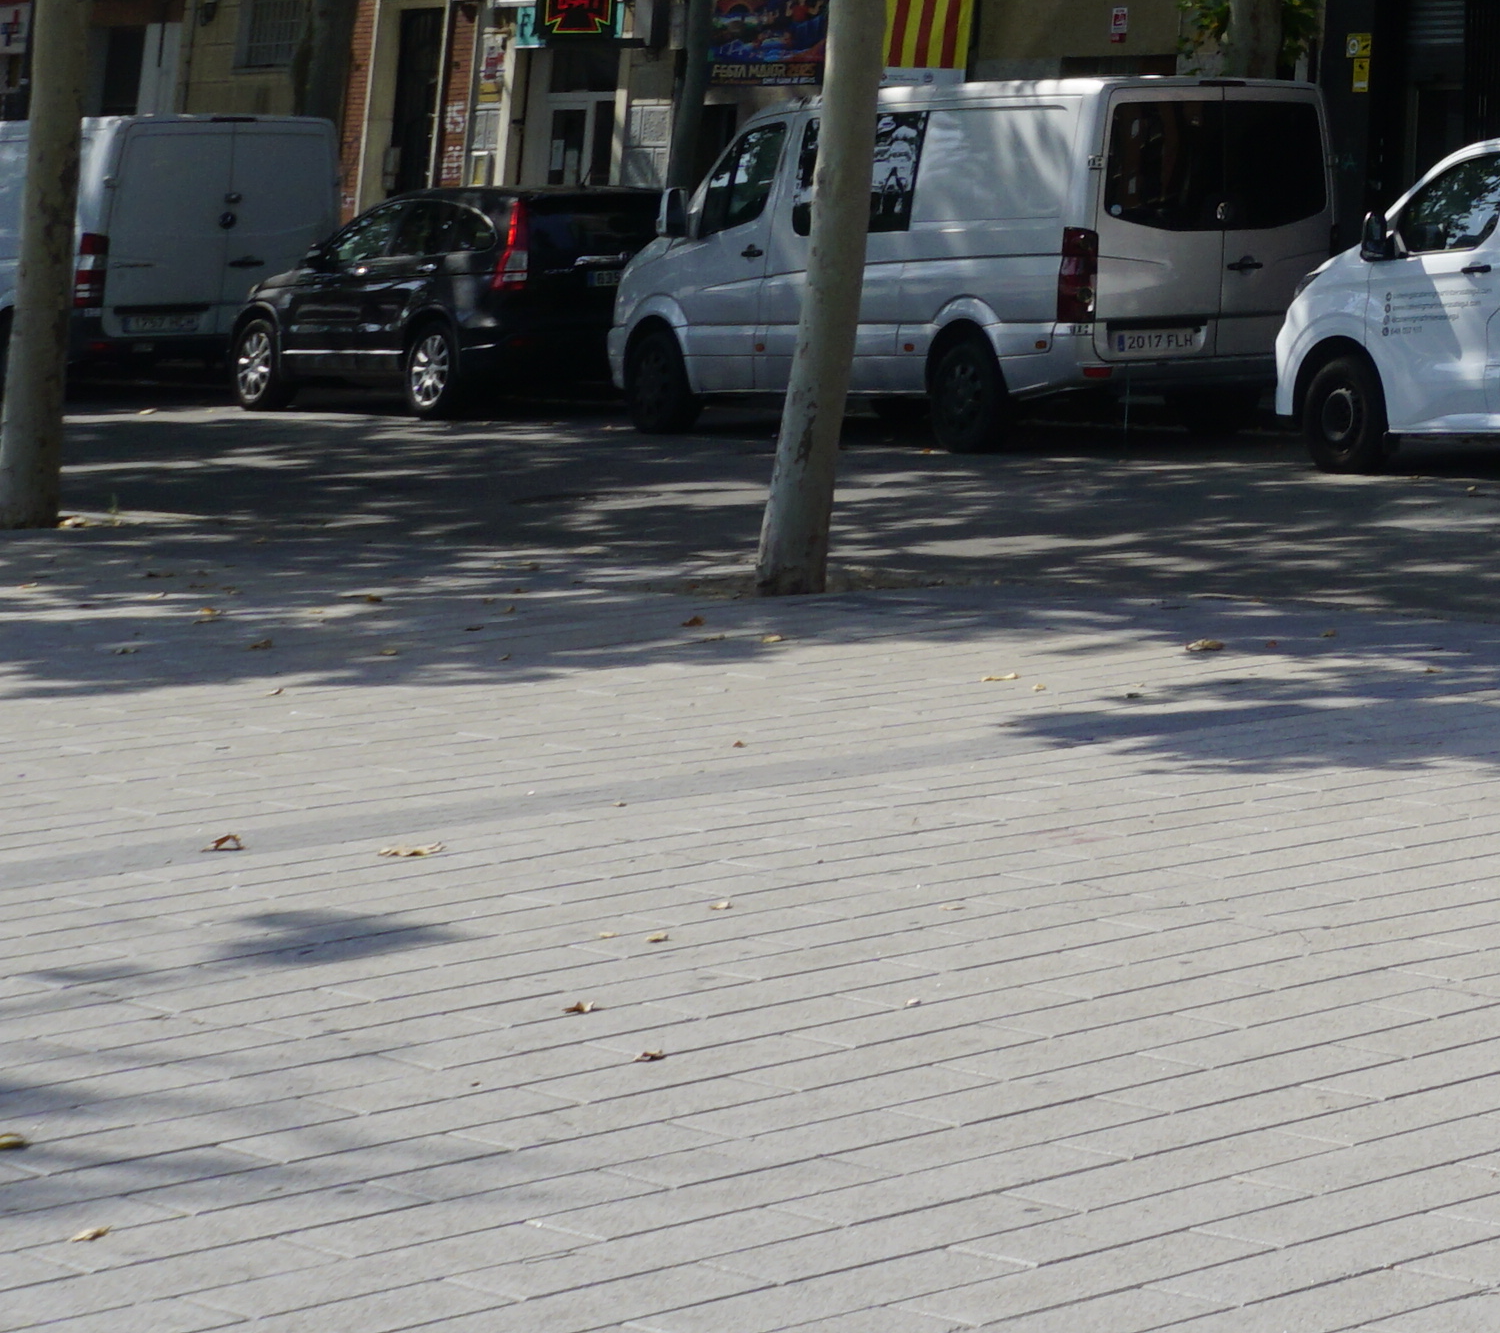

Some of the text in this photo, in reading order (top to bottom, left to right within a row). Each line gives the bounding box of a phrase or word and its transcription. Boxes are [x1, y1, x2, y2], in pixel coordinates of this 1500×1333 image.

[711, 64, 747, 78] FESTA
[1127, 334, 1193, 350] 2017 FLH
